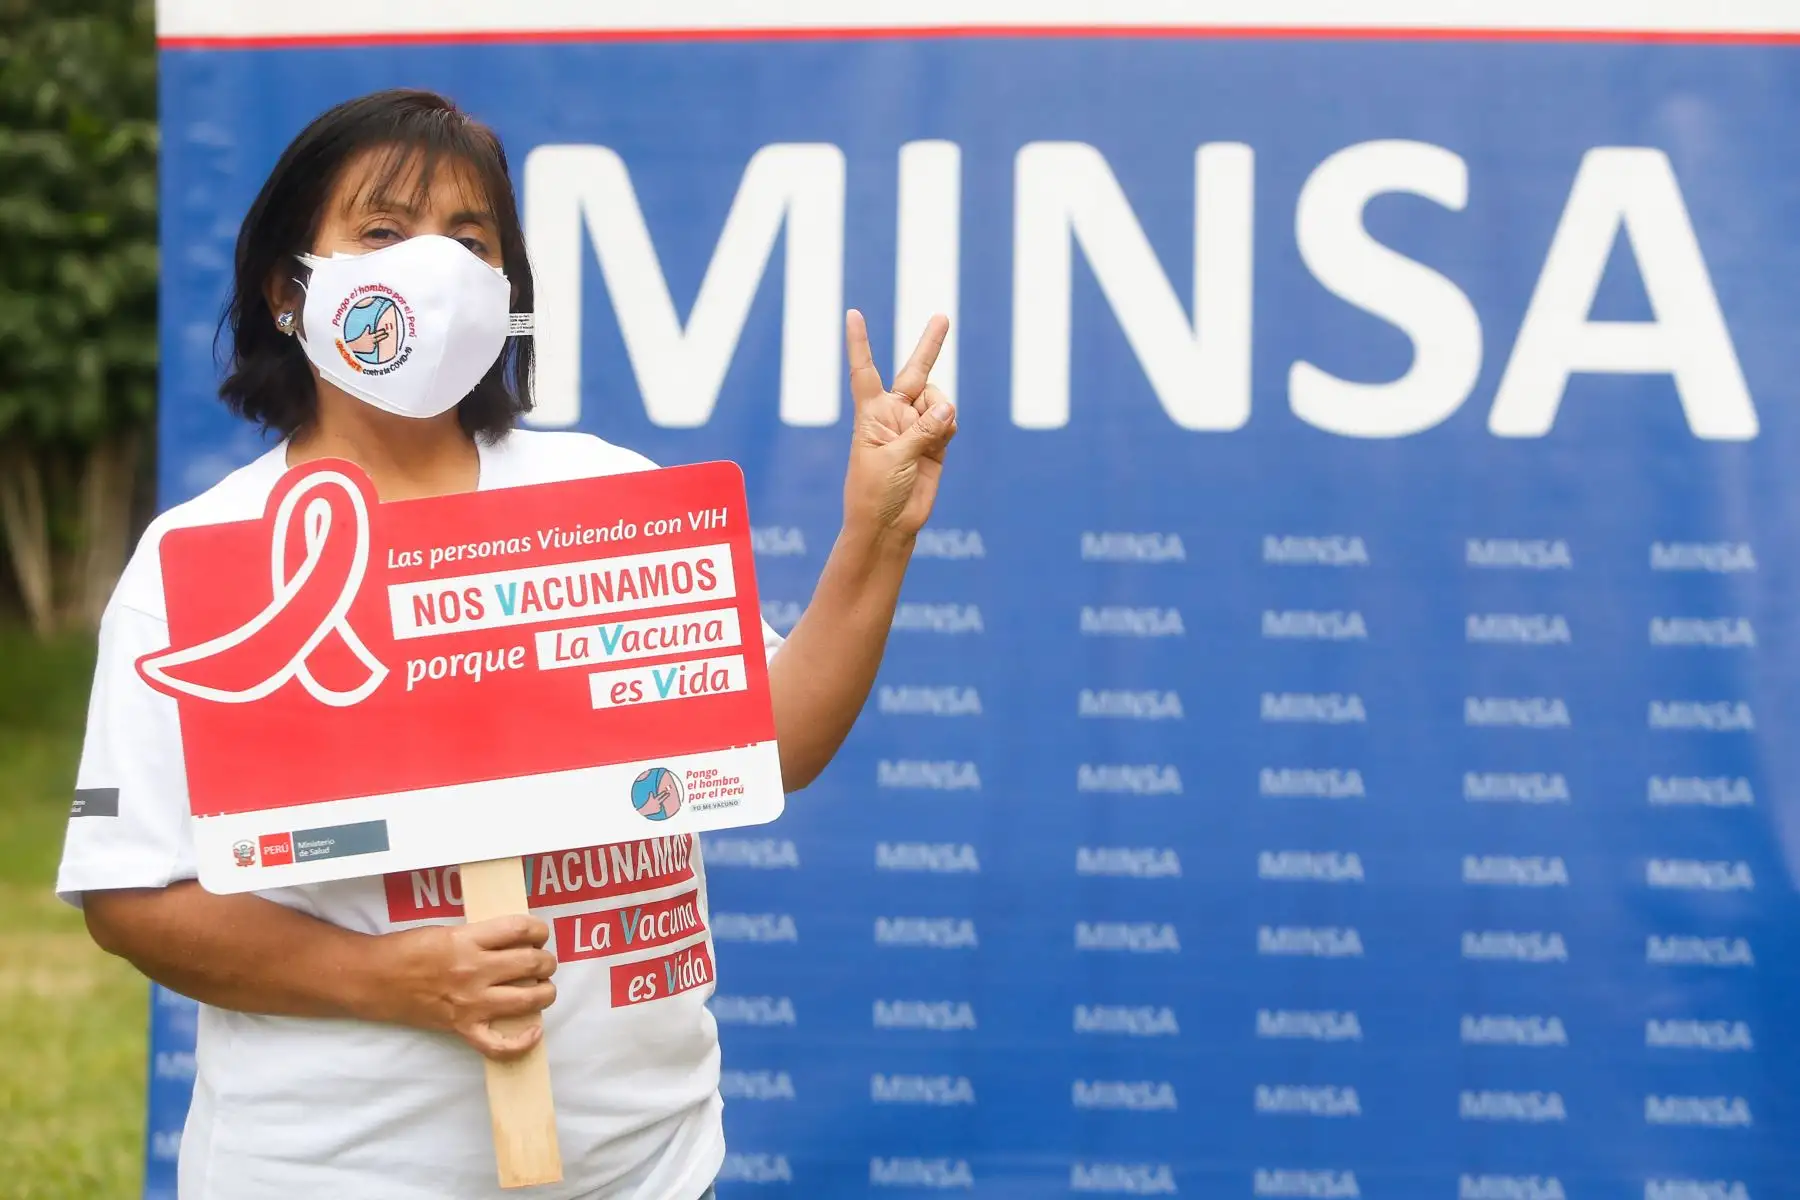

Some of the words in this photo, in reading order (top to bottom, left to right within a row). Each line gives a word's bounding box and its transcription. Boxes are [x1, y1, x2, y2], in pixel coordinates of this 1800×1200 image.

[332, 298, 350, 327] Pongo
[350, 289, 358, 299] el
[358, 283, 392, 296] hombro
[392, 292, 406, 305] por
[523, 140, 1760, 438] MINSA
[390, 346, 413, 372] COVID-19
[387, 548, 423, 569] Las
[429, 535, 532, 569] personas
[537, 519, 637, 550] Viviendo
[643, 518, 682, 537] con
[687, 507, 727, 531] VIH
[412, 588, 485, 627] NOS
[495, 558, 718, 616] VACUNAMOS
[406, 645, 526, 691] porque
[555, 632, 589, 661] La
[598, 618, 724, 655] Vacuna
[610, 678, 643, 704] es
[652, 662, 730, 698] Vida
[686, 769, 718, 779] Pongo
[687, 780, 697, 790] el
[700, 776, 739, 788] hombro
[689, 792, 706, 803] por
[709, 788, 718, 798] el
[720, 784, 744, 796] Perú
[264, 842, 288, 855] PERÚ
[297, 838, 335, 848] Ministerio
[299, 849, 309, 857] de
[310, 846, 330, 856] Salud
[411, 863, 465, 909] NO
[574, 918, 611, 953] La
[620, 902, 697, 944] Vacuna
[628, 972, 656, 1002] es
[664, 950, 708, 994] Vida
